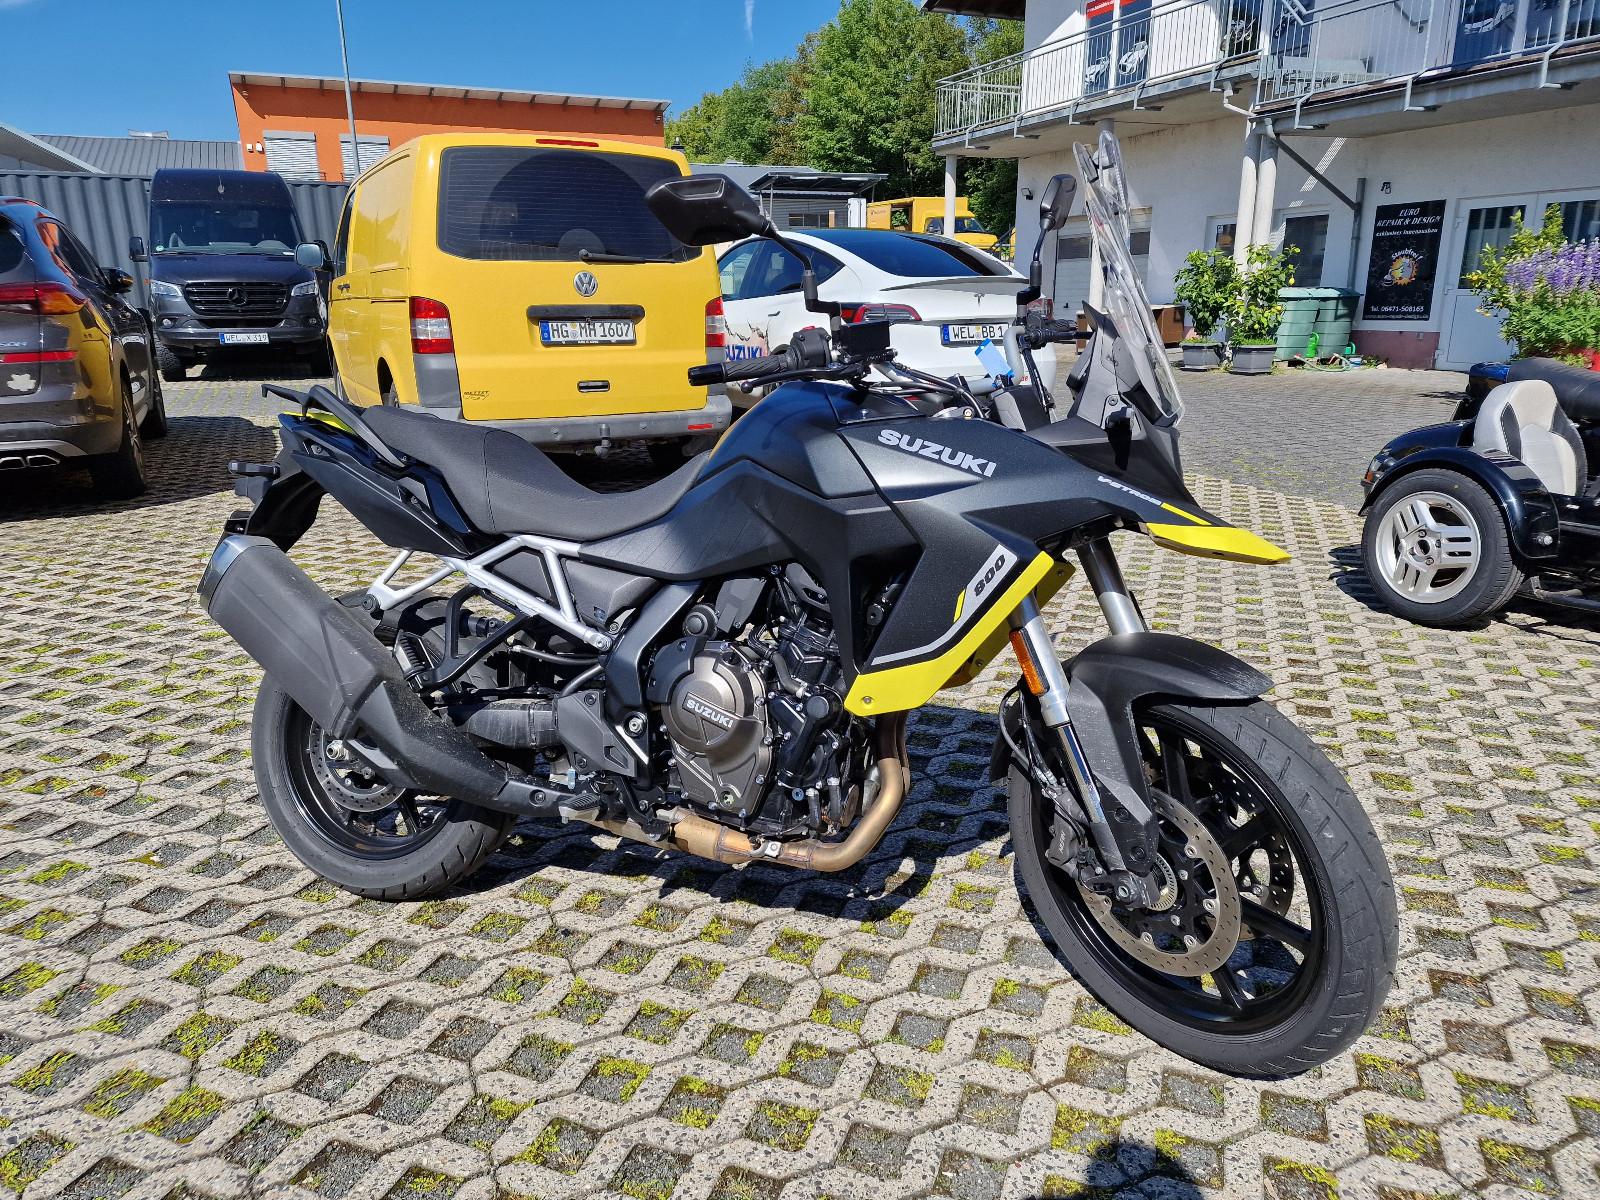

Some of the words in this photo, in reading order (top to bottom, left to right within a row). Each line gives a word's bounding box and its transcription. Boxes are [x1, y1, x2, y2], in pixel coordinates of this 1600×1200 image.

[1399, 208, 1420, 217] EURO
[1376, 218, 1404, 227] REPAIR
[1403, 217, 1411, 225] &
[1411, 215, 1441, 225] DESIGN
[225, 334, 242, 342] WEL
[551, 322, 570, 339] HG
[599, 322, 631, 338] 1607
[952, 326, 975, 340] WEL
[981, 325, 996, 339] BB
[878, 429, 997, 478] SUZUKI
[973, 554, 1006, 597] 800
[686, 699, 734, 728] SUZUKI
